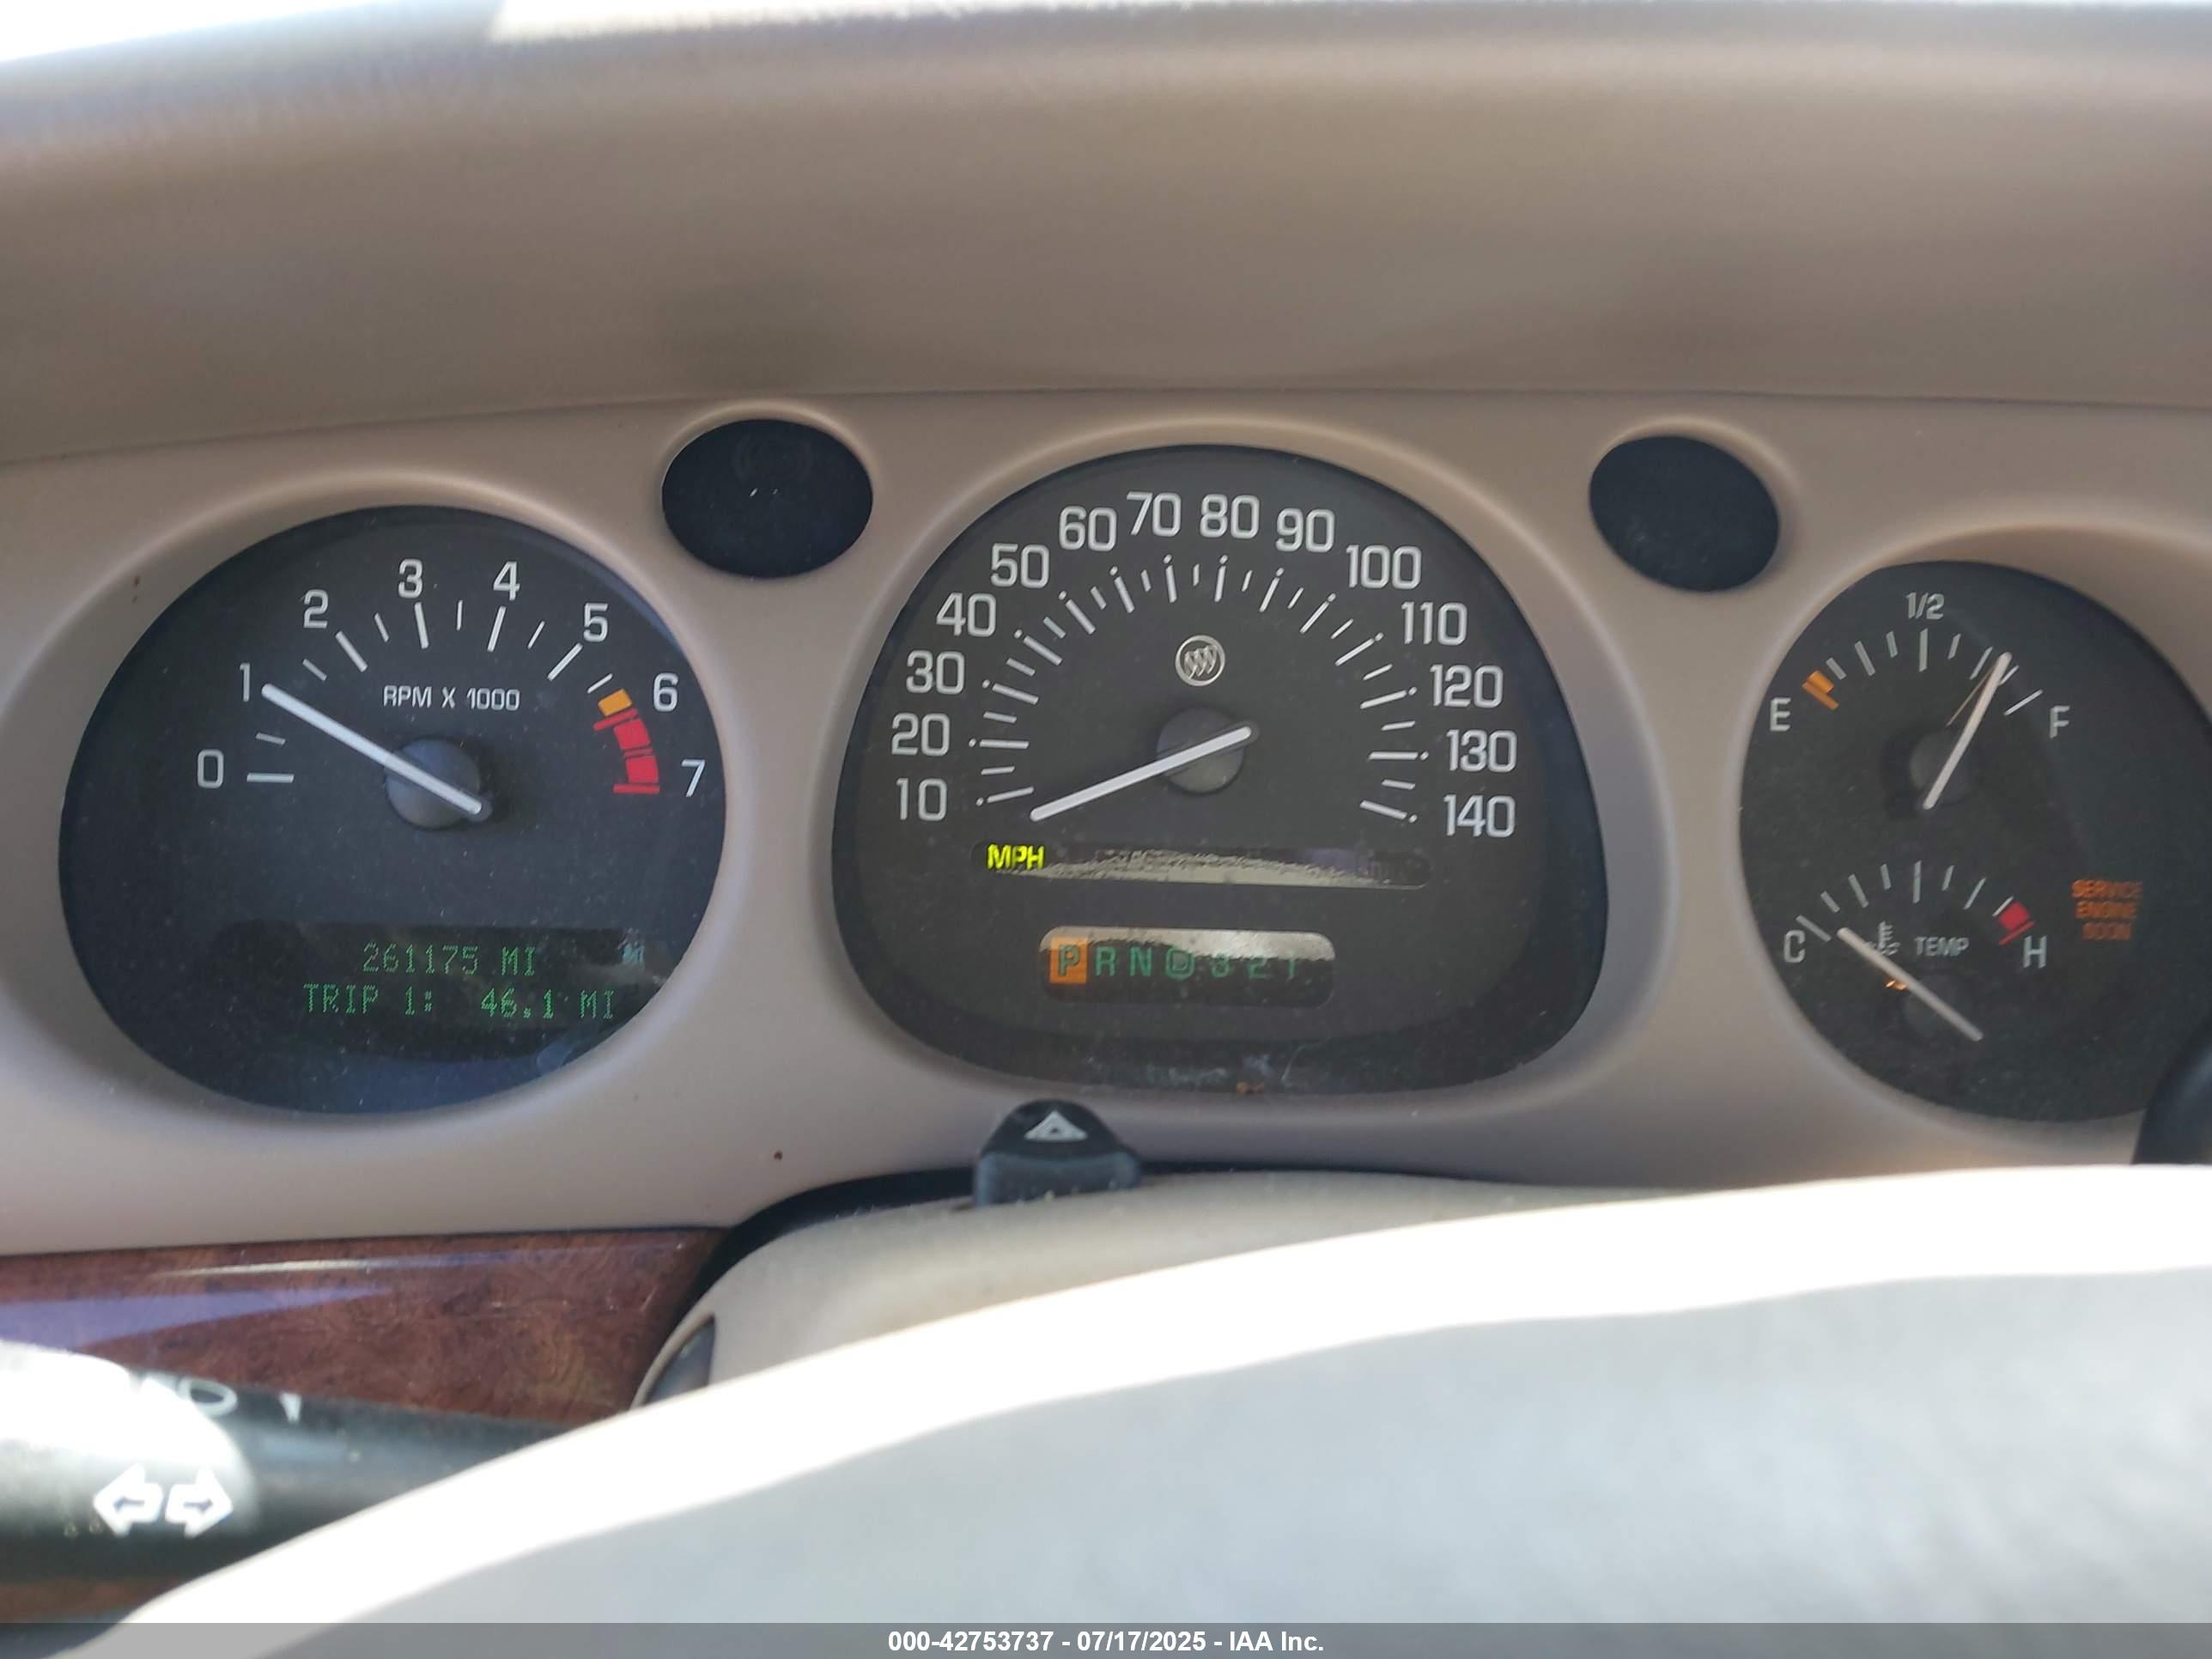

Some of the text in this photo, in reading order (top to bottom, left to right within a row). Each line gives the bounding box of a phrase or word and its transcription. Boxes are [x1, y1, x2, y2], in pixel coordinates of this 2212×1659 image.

[1059, 506, 1117, 551] 60
[1126, 492, 1182, 537] 70
[1200, 494, 1260, 539] 80
[1276, 507, 1334, 552] 90
[398, 559, 423, 599] 3
[493, 562, 520, 601] 4
[990, 543, 1049, 588] 50
[1346, 544, 1421, 589] 100
[303, 589, 329, 629] 2
[583, 603, 608, 642] 5
[936, 592, 996, 637] 40
[1401, 601, 1468, 646] 110
[1906, 592, 1945, 620] 1/2
[240, 663, 251, 702] 1
[653, 672, 678, 712] 6
[906, 650, 965, 695] 30
[1430, 664, 1504, 708] 120
[383, 685, 520, 711] RPM X 1000
[1770, 697, 1791, 732] E
[891, 713, 950, 757] 20
[2050, 705, 2070, 738] F
[197, 749, 224, 788] 0
[1446, 729, 1516, 772] 130
[681, 759, 705, 798] 7
[896, 778, 947, 821] 10
[1443, 794, 1516, 837] 140
[988, 844, 1044, 870] MPH
[362, 942, 536, 976] 261175 MI
[1784, 929, 1805, 963] C
[1914, 936, 1969, 957] TEMP
[2023, 935, 2047, 969] H
[303, 982, 616, 1019] TRIP 1: 46.1 MI
